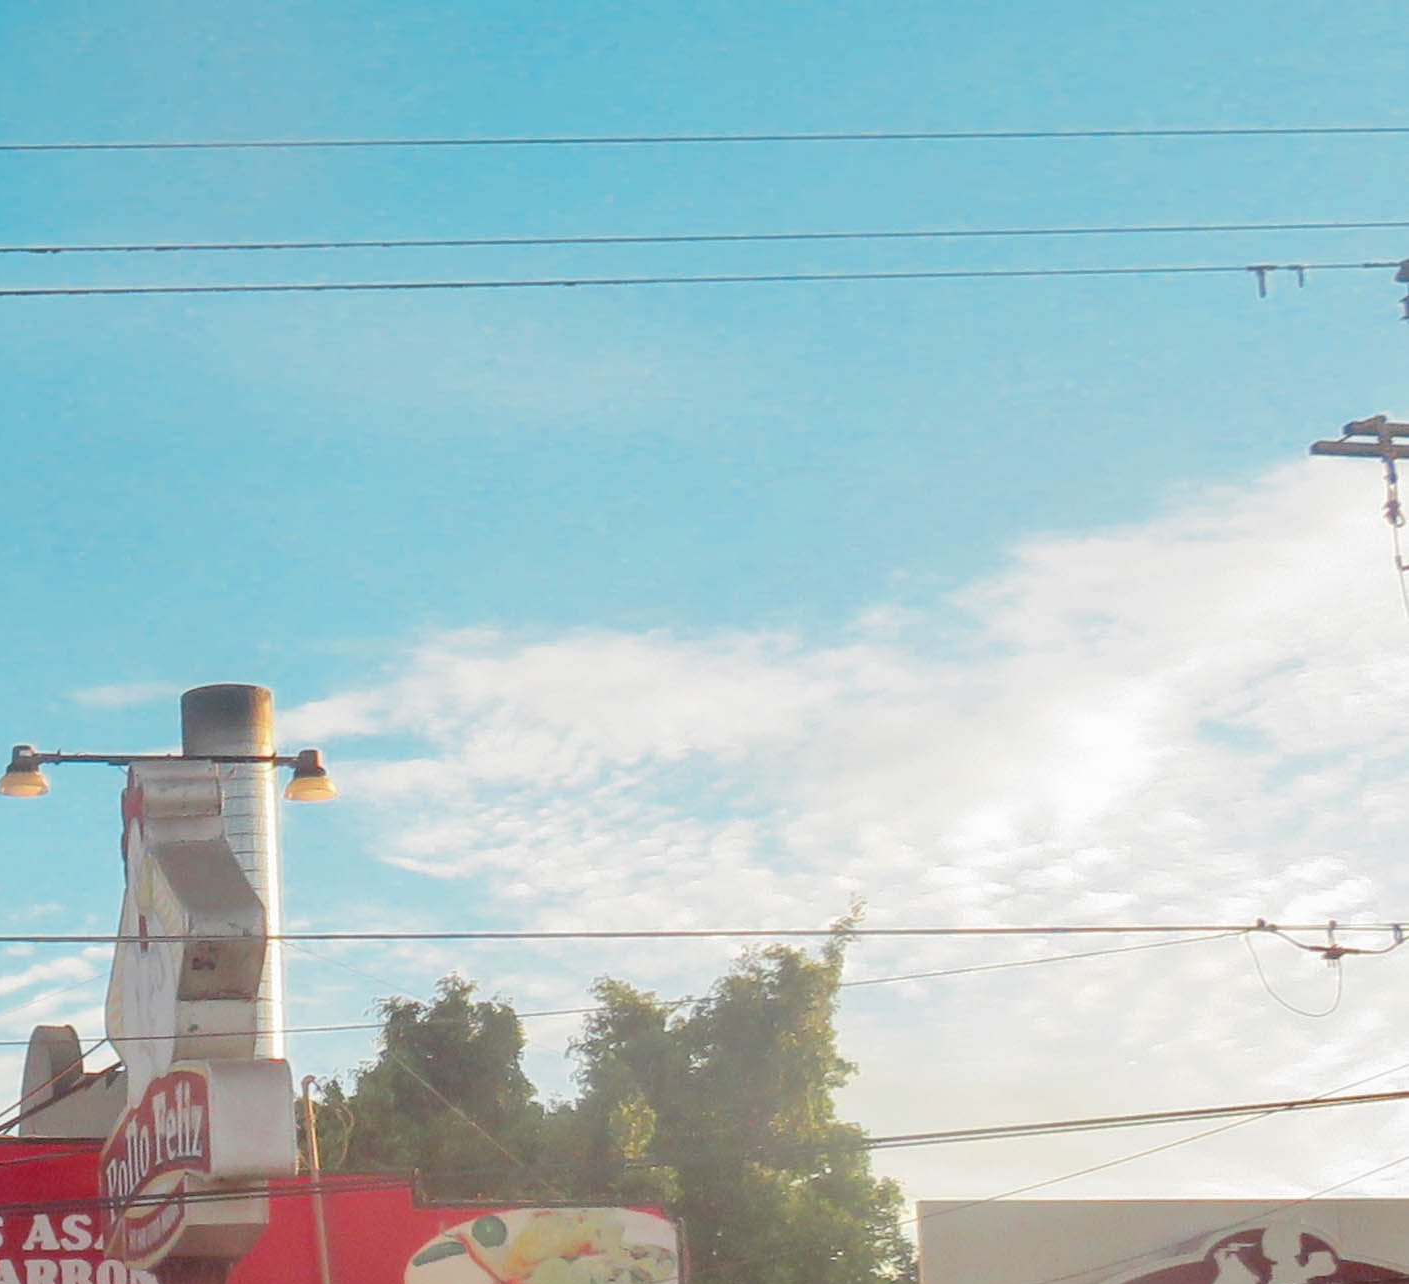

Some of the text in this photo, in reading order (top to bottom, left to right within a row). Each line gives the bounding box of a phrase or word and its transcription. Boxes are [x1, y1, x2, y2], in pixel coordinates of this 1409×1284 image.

[106, 1114, 150, 1225] Pollo
[152, 1079, 204, 1166] Feliz
[22, 1214, 105, 1251] AS
